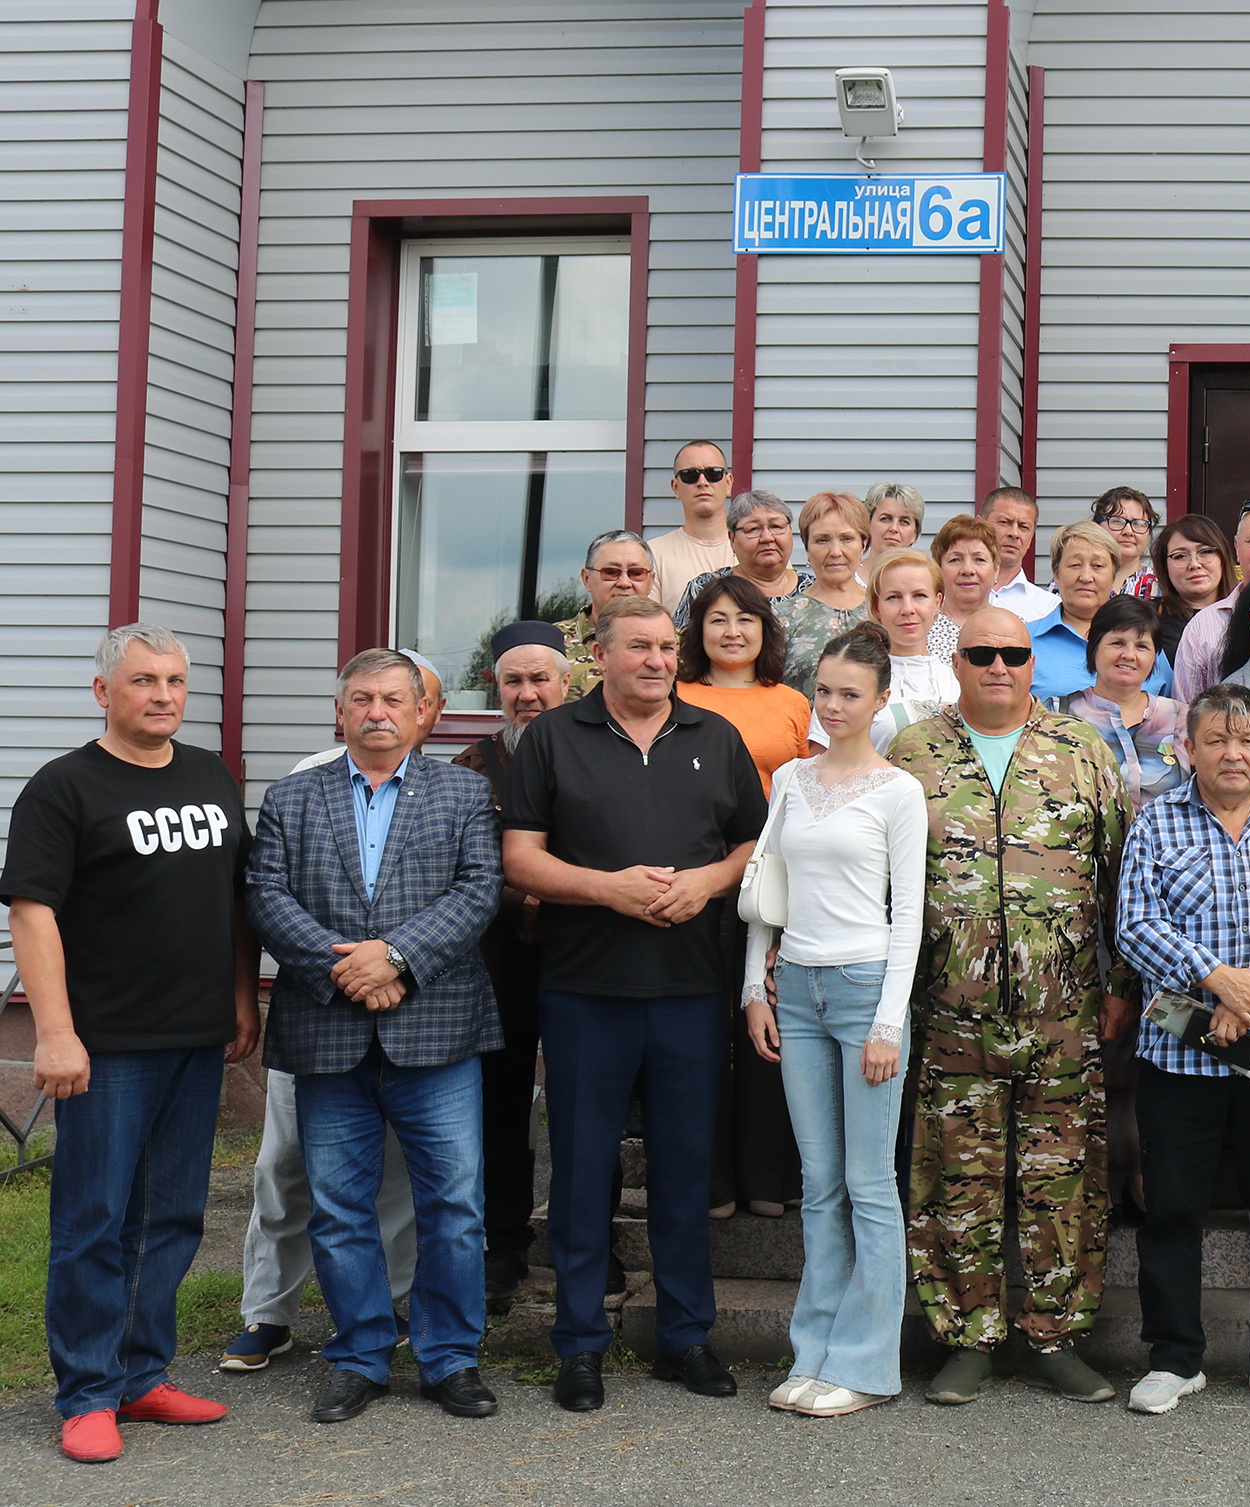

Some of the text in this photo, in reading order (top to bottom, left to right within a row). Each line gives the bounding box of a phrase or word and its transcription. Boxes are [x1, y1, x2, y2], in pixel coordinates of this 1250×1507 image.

[744, 184, 992, 246] ЦЕНТРАЛЬНАЯ 6а
[854, 183, 911, 200] улица
[126, 803, 229, 856] СССР
